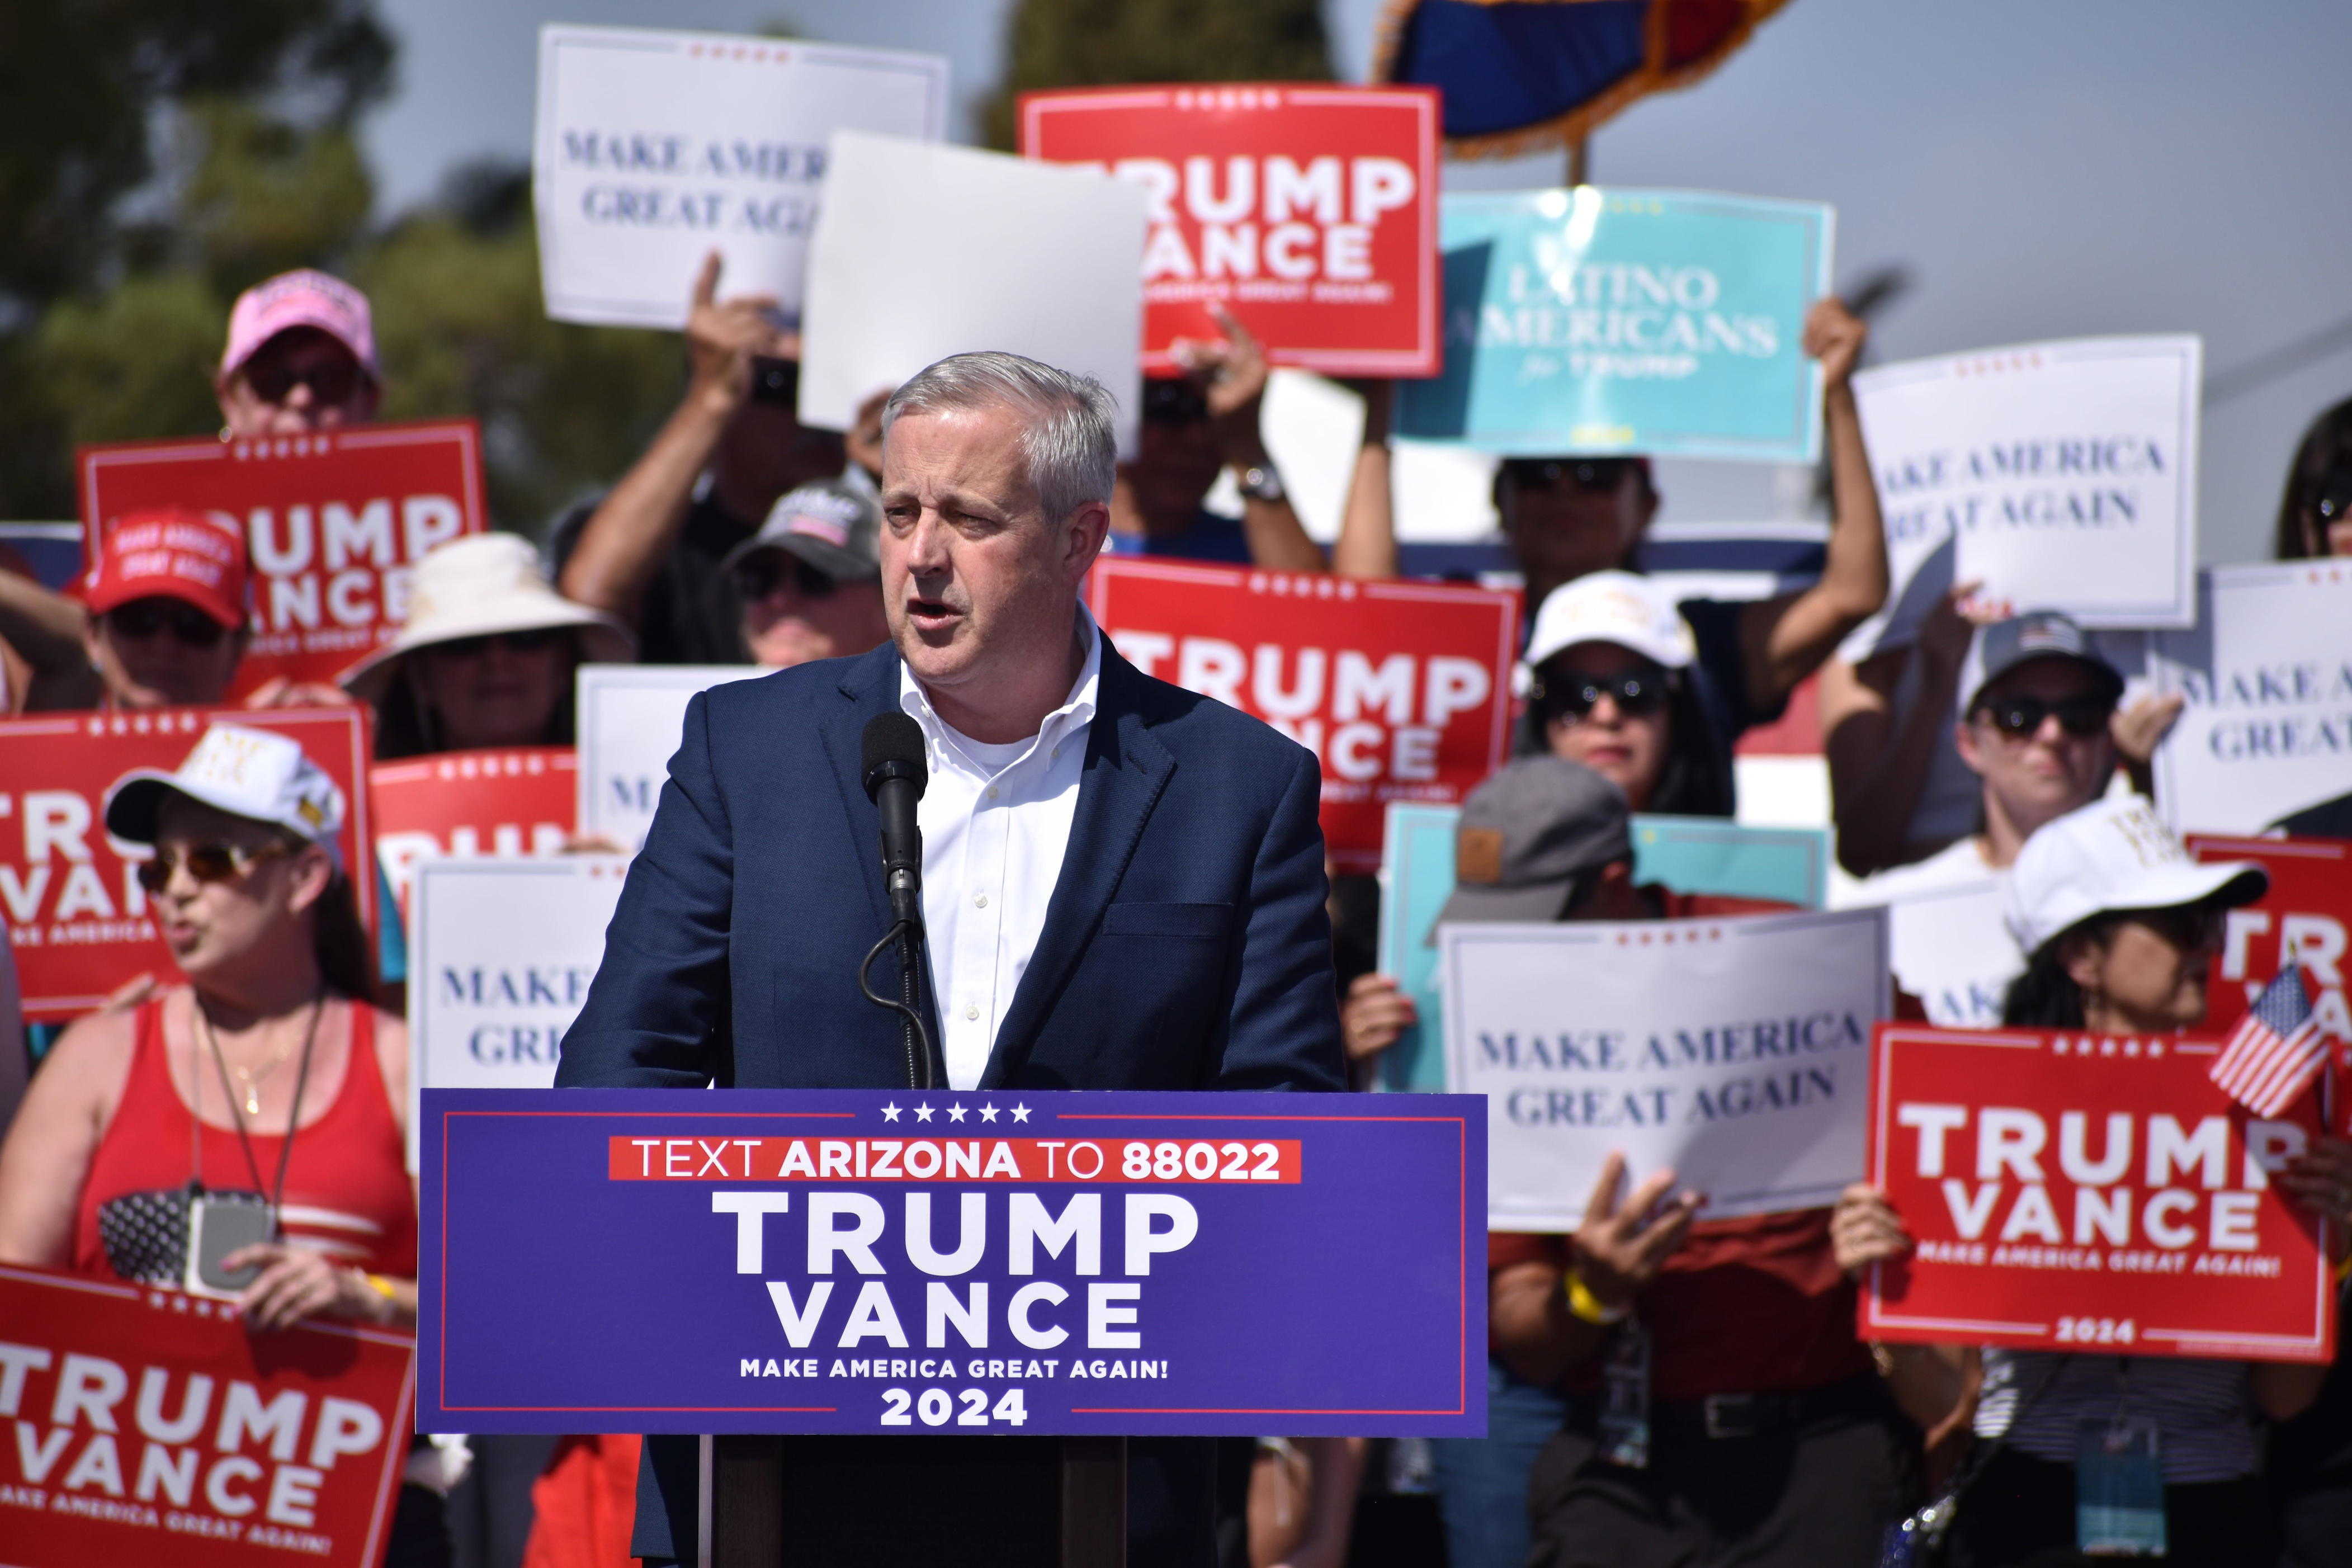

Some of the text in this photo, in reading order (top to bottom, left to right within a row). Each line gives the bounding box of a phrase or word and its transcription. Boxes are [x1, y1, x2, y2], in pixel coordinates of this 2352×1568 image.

[562, 129, 830, 186] MAKE AMER
[582, 186, 724, 230] GREAT
[1054, 155, 1418, 224] RUMP
[1142, 224, 1374, 280] ANCE
[1509, 263, 1720, 311] LATINO
[1568, 351, 1700, 380] TRUMP
[1885, 435, 2165, 497] AKE AMERICA
[204, 493, 463, 575] UMP
[1887, 484, 2141, 545] REAT AGAIN
[250, 567, 415, 633] NCE
[1110, 631, 1492, 727] TRUMP
[2183, 662, 2321, 707] MAKE
[2209, 710, 2352, 762] GREA
[1479, 1011, 1864, 1073] MAKE AMERICA
[1507, 1067, 1838, 1127] GREAT AGAIN
[632, 1139, 1280, 1180] TEXT ARIZONA TO 88022
[1897, 1103, 2310, 1191] TRUMP
[712, 1191, 1199, 1277] TRUMP
[1942, 1179, 2261, 1251] VANCE
[1916, 1240, 2282, 1278] MAKE AMERICA GREAT AGAIN!
[766, 1281, 1141, 1350] VANCE
[2055, 1317, 2135, 1343] 2024
[741, 1359, 1168, 1380] MAKE AMERICA GREAT AGAIN!
[0, 1343, 384, 1471] TRUMP
[881, 1388, 1028, 1427] 2024
[15, 1419, 324, 1529] VANCE
[0, 1484, 333, 1557] AKE AMERICA GREAT AGAIN!
